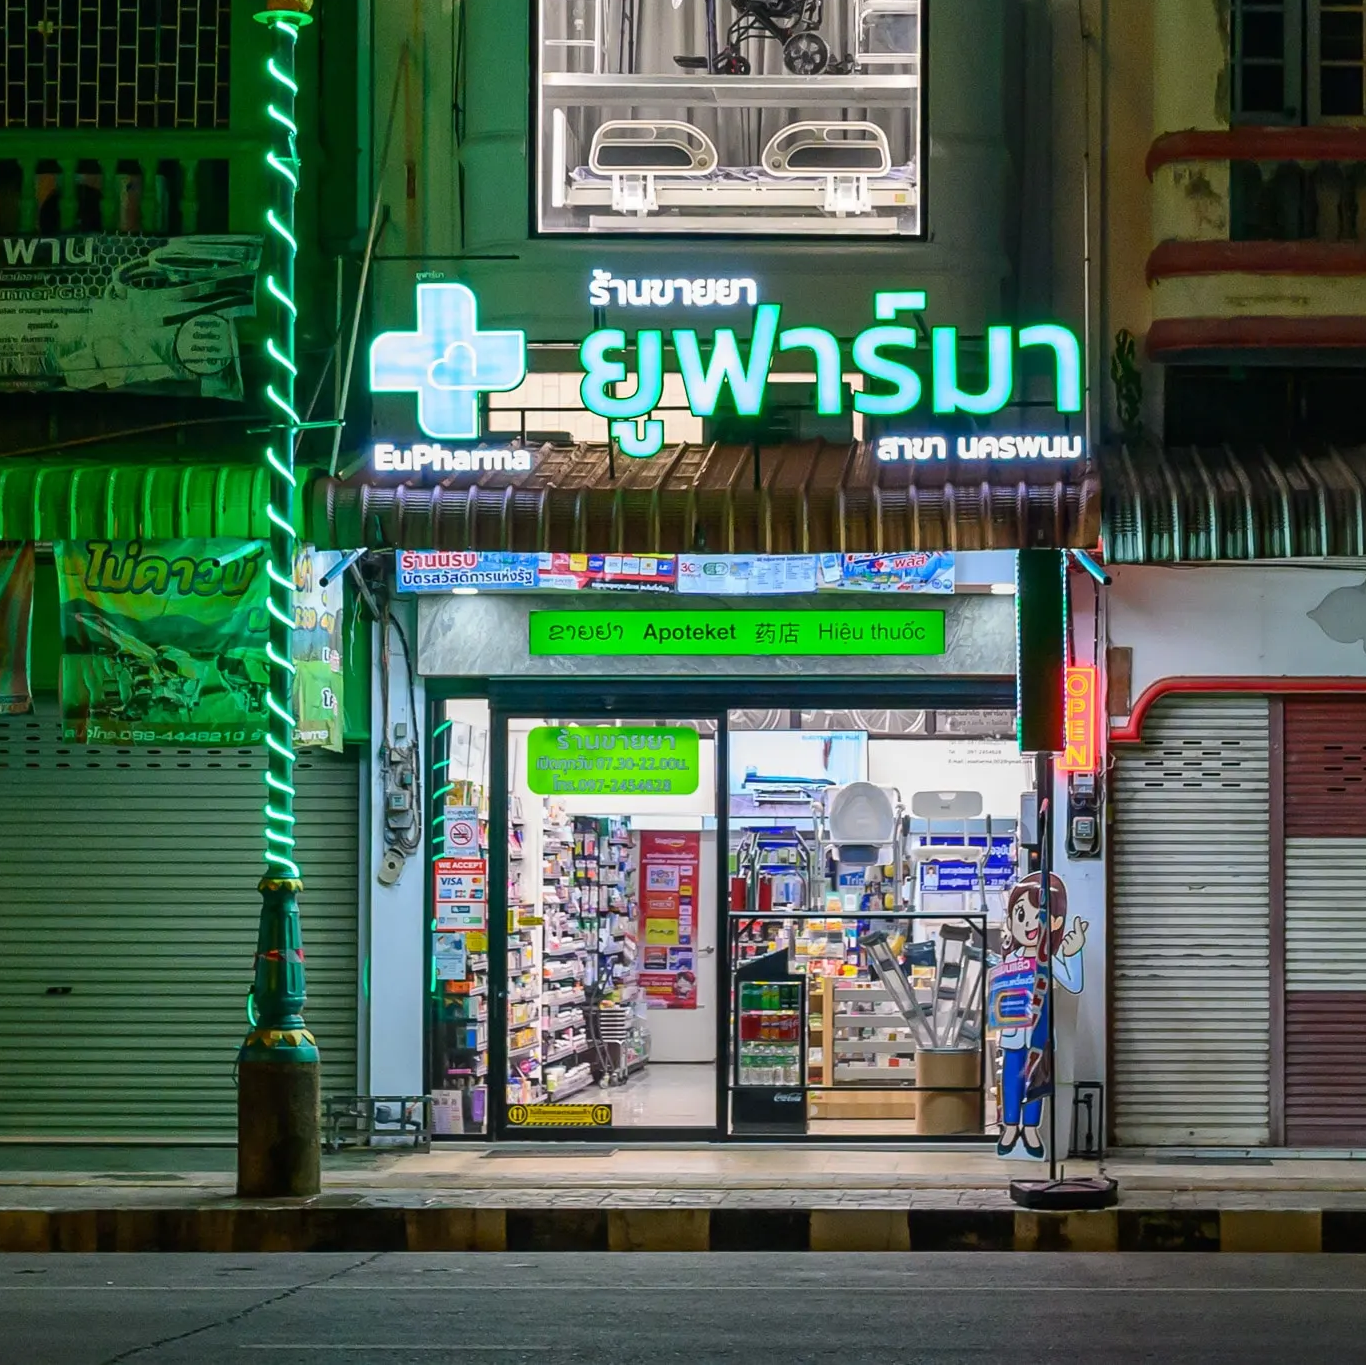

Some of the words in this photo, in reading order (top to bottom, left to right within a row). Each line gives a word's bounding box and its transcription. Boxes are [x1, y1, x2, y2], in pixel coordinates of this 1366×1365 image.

[588, 269, 758, 307] ร้านขายยา
[579, 290, 1086, 457] ยูฟาร์มา
[374, 442, 531, 471] EuPharma
[876, 435, 947, 462] สาขา
[957, 435, 1083, 461] นครพนม
[403, 568, 533, 585] บัตรสวัสดิการแห่งรัฐ
[643, 622, 737, 644] Apoteket
[754, 622, 800, 644] 药店
[818, 623, 862, 643] Hiệu
[871, 620, 926, 641] thuốc
[1066, 674, 1089, 766] OPEN
[556, 729, 676, 751] ร้านขายยา
[536, 755, 593, 775] เปิดทุกวัน
[438, 861, 451, 869] WE
[452, 861, 484, 869] ACCEPT
[440, 877, 464, 886] VISA
